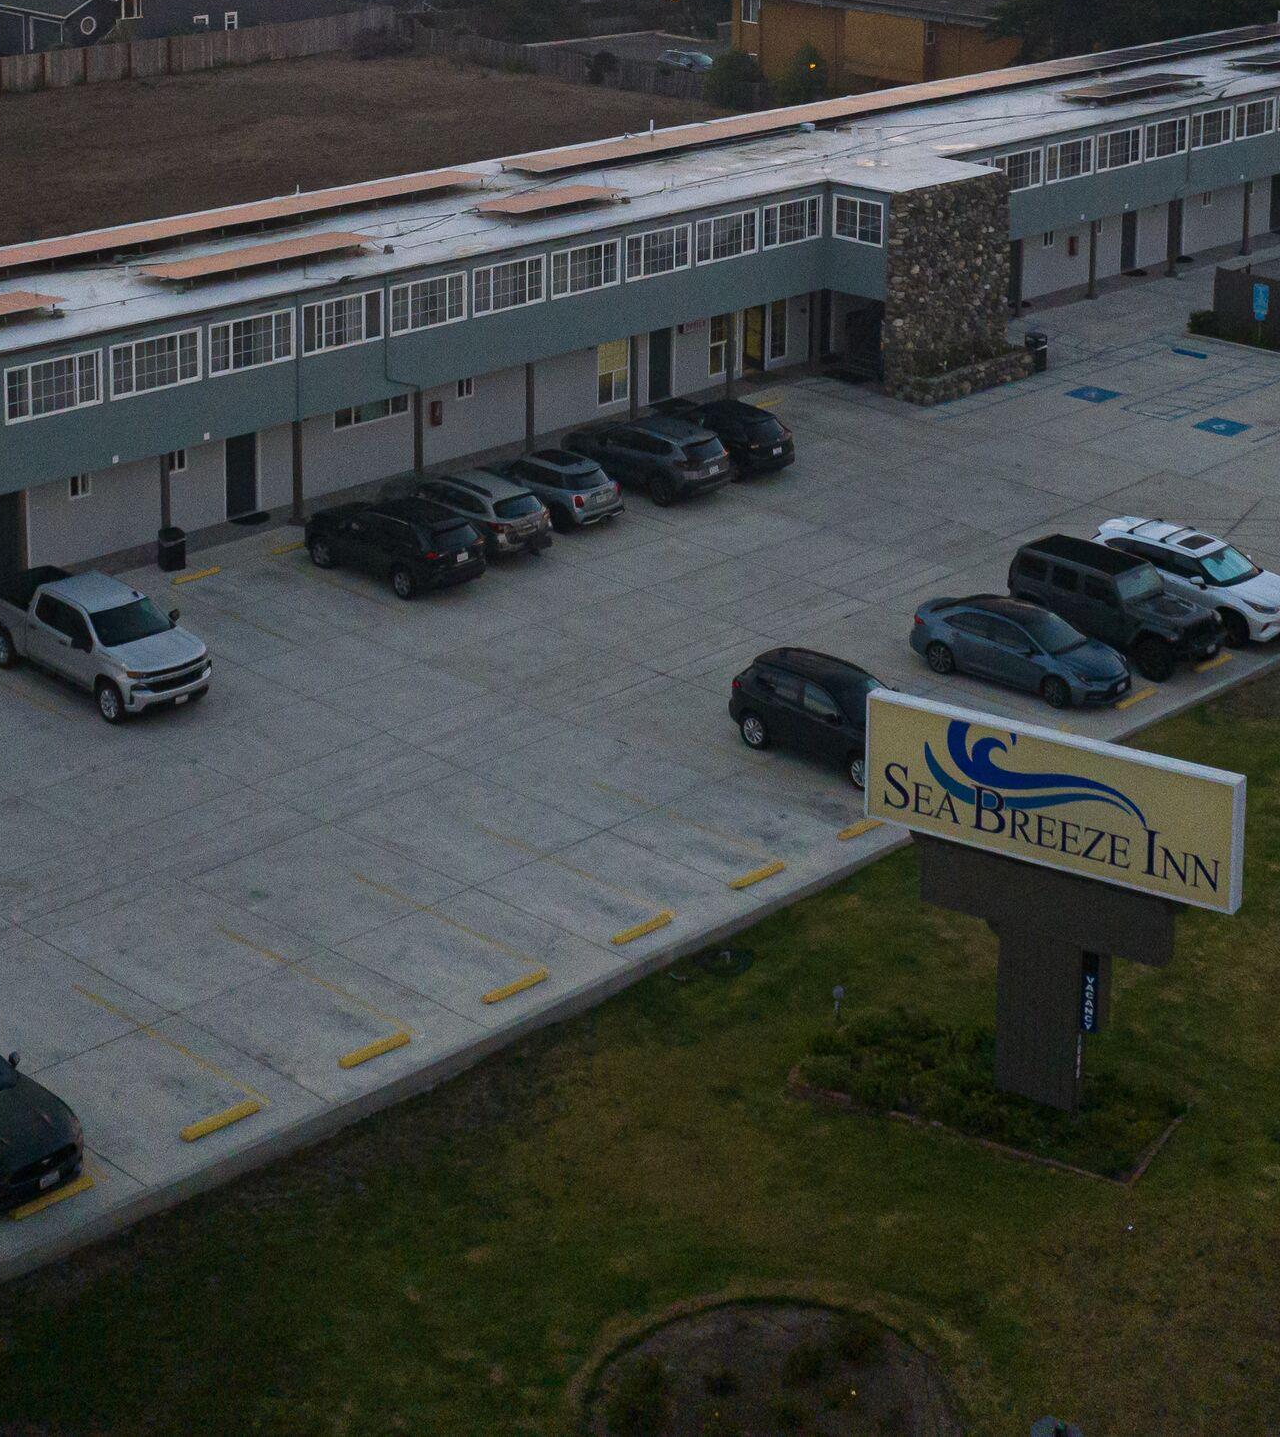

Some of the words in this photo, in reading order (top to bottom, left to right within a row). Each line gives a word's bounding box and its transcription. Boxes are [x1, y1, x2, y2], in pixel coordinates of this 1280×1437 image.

[883, 762, 961, 825] SEA
[971, 785, 1131, 869] BREEZE
[1143, 829, 1220, 893] INN
[1084, 976, 1095, 1030] VACANCY
